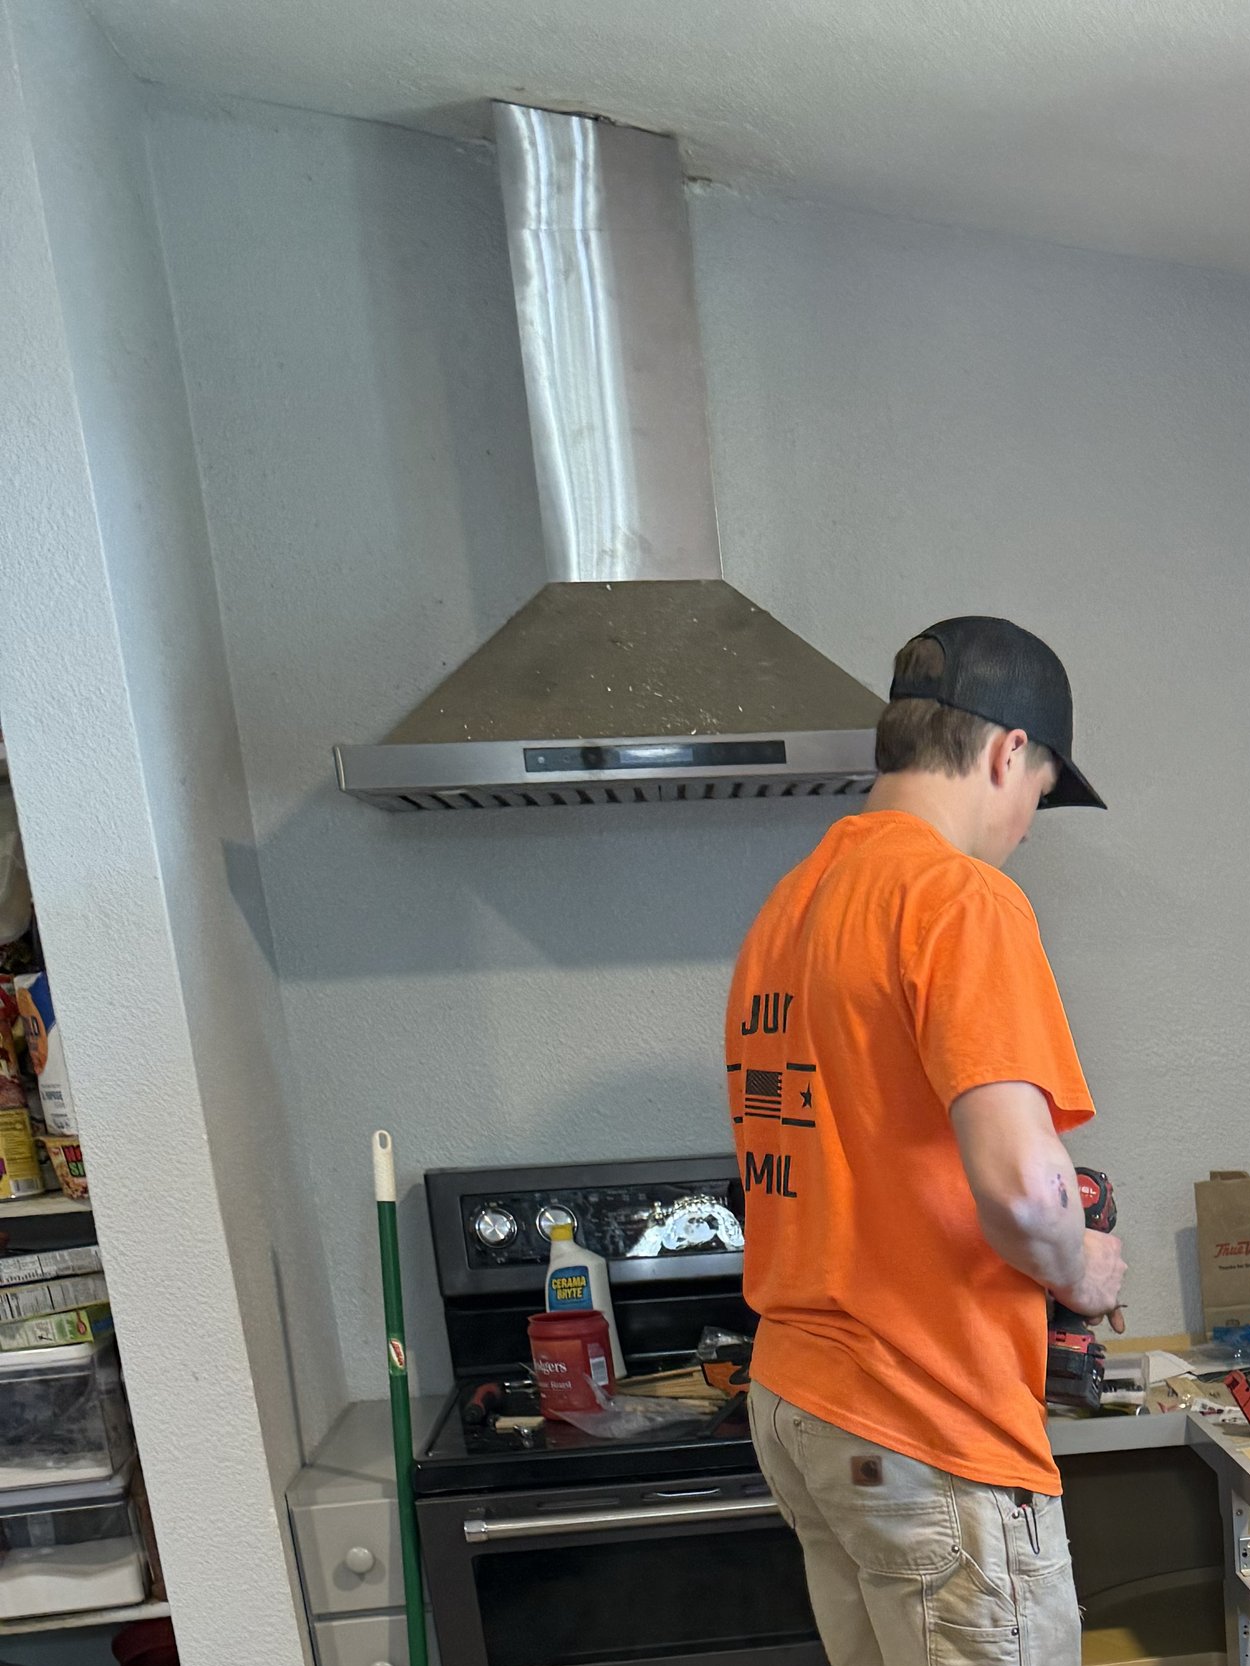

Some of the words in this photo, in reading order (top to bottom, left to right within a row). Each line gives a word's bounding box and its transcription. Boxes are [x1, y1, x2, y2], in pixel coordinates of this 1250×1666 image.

[552, 1276, 586, 1290] CERAMA
[557, 1287, 583, 1300] BRYTE
[536, 1359, 567, 1375] olgers
